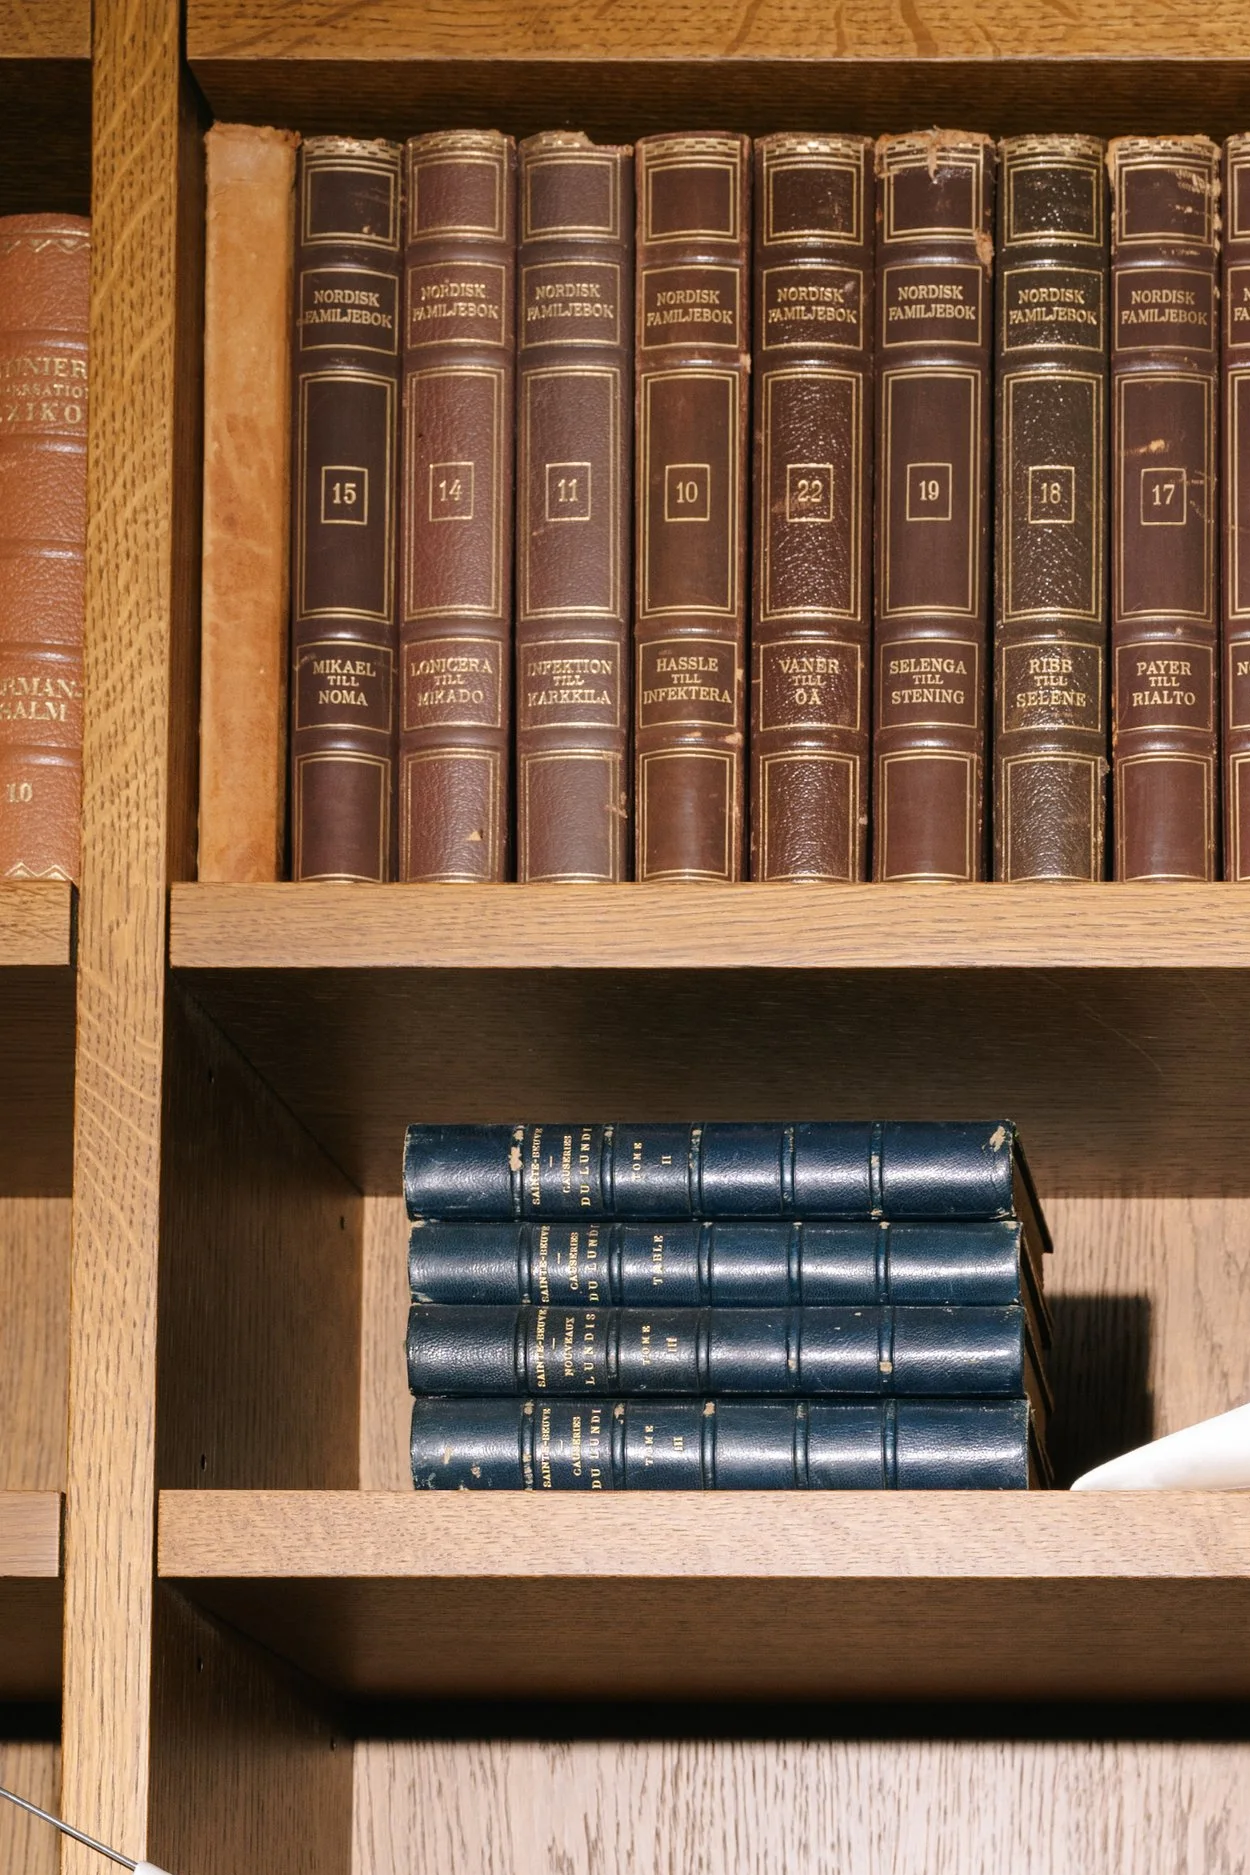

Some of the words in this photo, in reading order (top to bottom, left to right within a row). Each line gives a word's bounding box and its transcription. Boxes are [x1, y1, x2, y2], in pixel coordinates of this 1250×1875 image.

[314, 290, 380, 307] NORDISK
[421, 283, 486, 300] NORDISK
[535, 283, 600, 300] NORDISK
[657, 290, 720, 306] NORDISK
[777, 286, 844, 303] NORDISK
[898, 285, 963, 300] NORDISK
[1018, 288, 1085, 305] NORDISK
[1131, 290, 1196, 305] NORDISK
[304, 308, 392, 328] FAMILJEBOK
[412, 303, 499, 322] FAMILJEBOK
[527, 303, 614, 321] FAMILJEBOK
[646, 308, 733, 326] FAMILJEBOK
[768, 306, 857, 324] FAMILJEBOK
[888, 304, 976, 321] FAMILJEBOK
[1009, 307, 1098, 325] FAMILJEBOK
[1121, 310, 1208, 326] FAMILJEBOK
[332, 483, 357, 504] 15
[439, 479, 462, 502] 14
[557, 479, 578, 502] 11
[676, 481, 698, 503] 10
[797, 480, 823, 503] 22
[919, 481, 939, 501] 19
[1040, 483, 1061, 504] 18
[1152, 484, 1175, 505] 17
[313, 659, 376, 677] MIKAEL
[410, 658, 493, 676] LONICERA
[528, 660, 612, 676] INFEKTION
[656, 657, 719, 672] HASSLE
[889, 658, 967, 675] SELENGA
[1029, 658, 1073, 674] RIBB
[1136, 661, 1192, 676] PAYER
[327, 675, 359, 687] TILL
[434, 674, 465, 686] TILL
[553, 675, 585, 686] TILL
[672, 673, 702, 684] TILL
[792, 674, 827, 686] TILL
[913, 673, 944, 685] TILL
[1035, 676, 1067, 687] TILL
[1150, 676, 1180, 687] TILL
[318, 690, 368, 707] NOMA
[417, 689, 484, 707] MIKADO
[528, 690, 612, 707] KARKKILA
[643, 687, 732, 705] INFEKTERA
[891, 690, 965, 704] STENING
[1016, 691, 1087, 707] SELENE
[1132, 691, 1196, 706] RIALTO
[6, 782, 33, 803] 10
[580, 1128, 593, 1175] LUNDI
[662, 1155, 672, 1165] II
[531, 1127, 543, 1205] SAINTE-BEUVE
[562, 1135, 572, 1193] CAUSERIES
[633, 1141, 642, 1181] TOME
[580, 1184, 591, 1206] DU
[586, 1224, 600, 1273] LUNDI
[539, 1225, 550, 1302] SAINTE-BEUVE
[569, 1232, 579, 1290] CAUSERIES
[653, 1234, 664, 1285] TABLE
[588, 1280, 599, 1301] DU
[536, 1308, 548, 1388] SAINTE-BEUVE
[564, 1317, 575, 1376] NOUVEAUX
[584, 1313, 596, 1385] LUNDIS
[642, 1325, 651, 1365] TOME
[668, 1337, 678, 1353] III
[590, 1408, 601, 1458] LUNDI
[541, 1408, 552, 1488] SAINTE-BEUVE
[572, 1416, 582, 1476] CAUSERIES
[645, 1425, 654, 1466] TOME
[673, 1436, 683, 1451] III
[591, 1467, 601, 1489] DU
